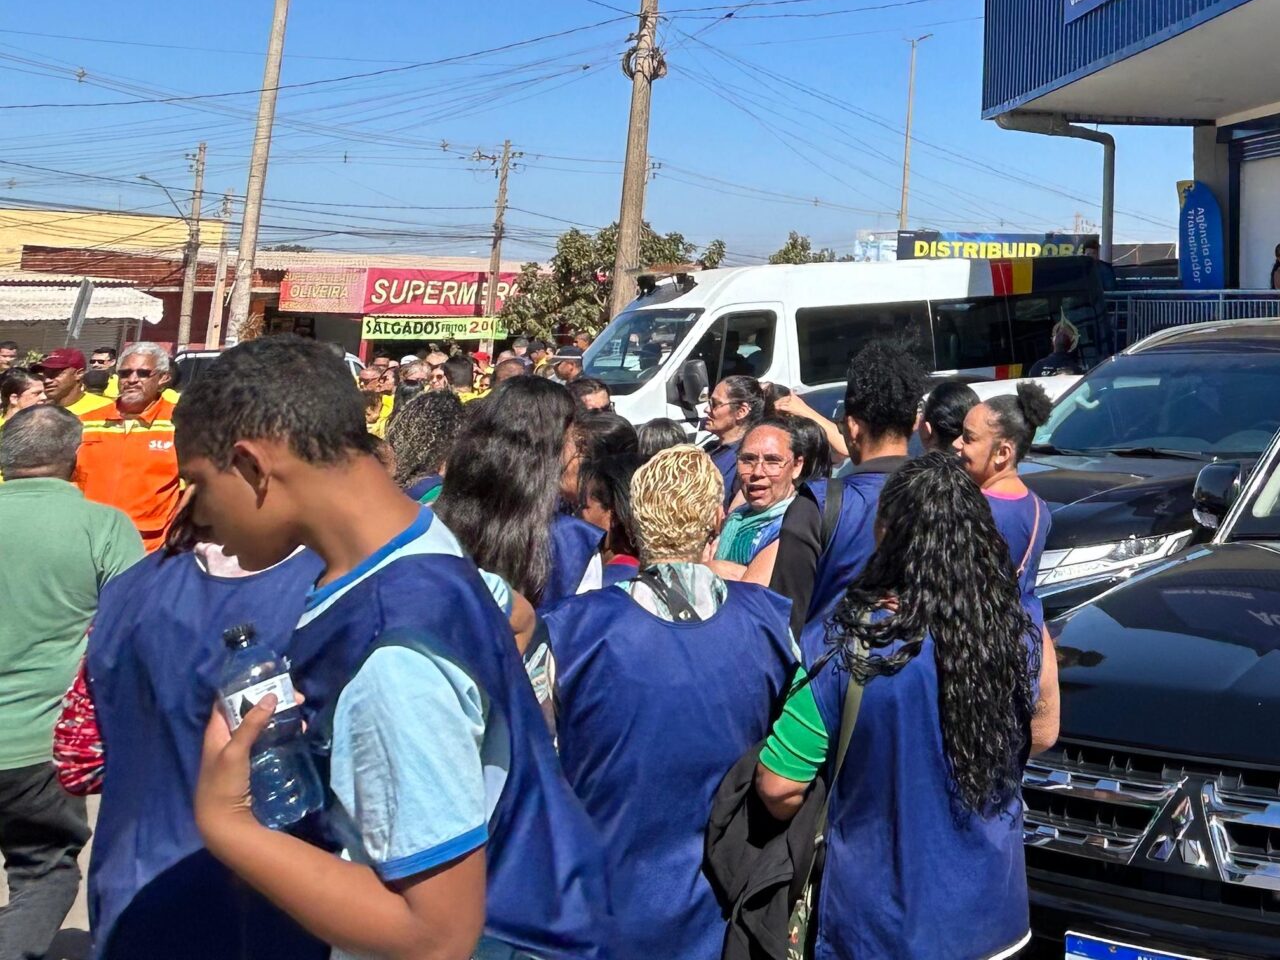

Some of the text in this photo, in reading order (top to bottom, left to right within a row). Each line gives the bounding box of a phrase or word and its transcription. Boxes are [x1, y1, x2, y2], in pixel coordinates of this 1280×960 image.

[1187, 209, 1201, 284] Trabalhador
[1204, 258, 1213, 275] do
[290, 284, 349, 299] OLIVEIRA
[365, 320, 441, 335] SALGADOS
